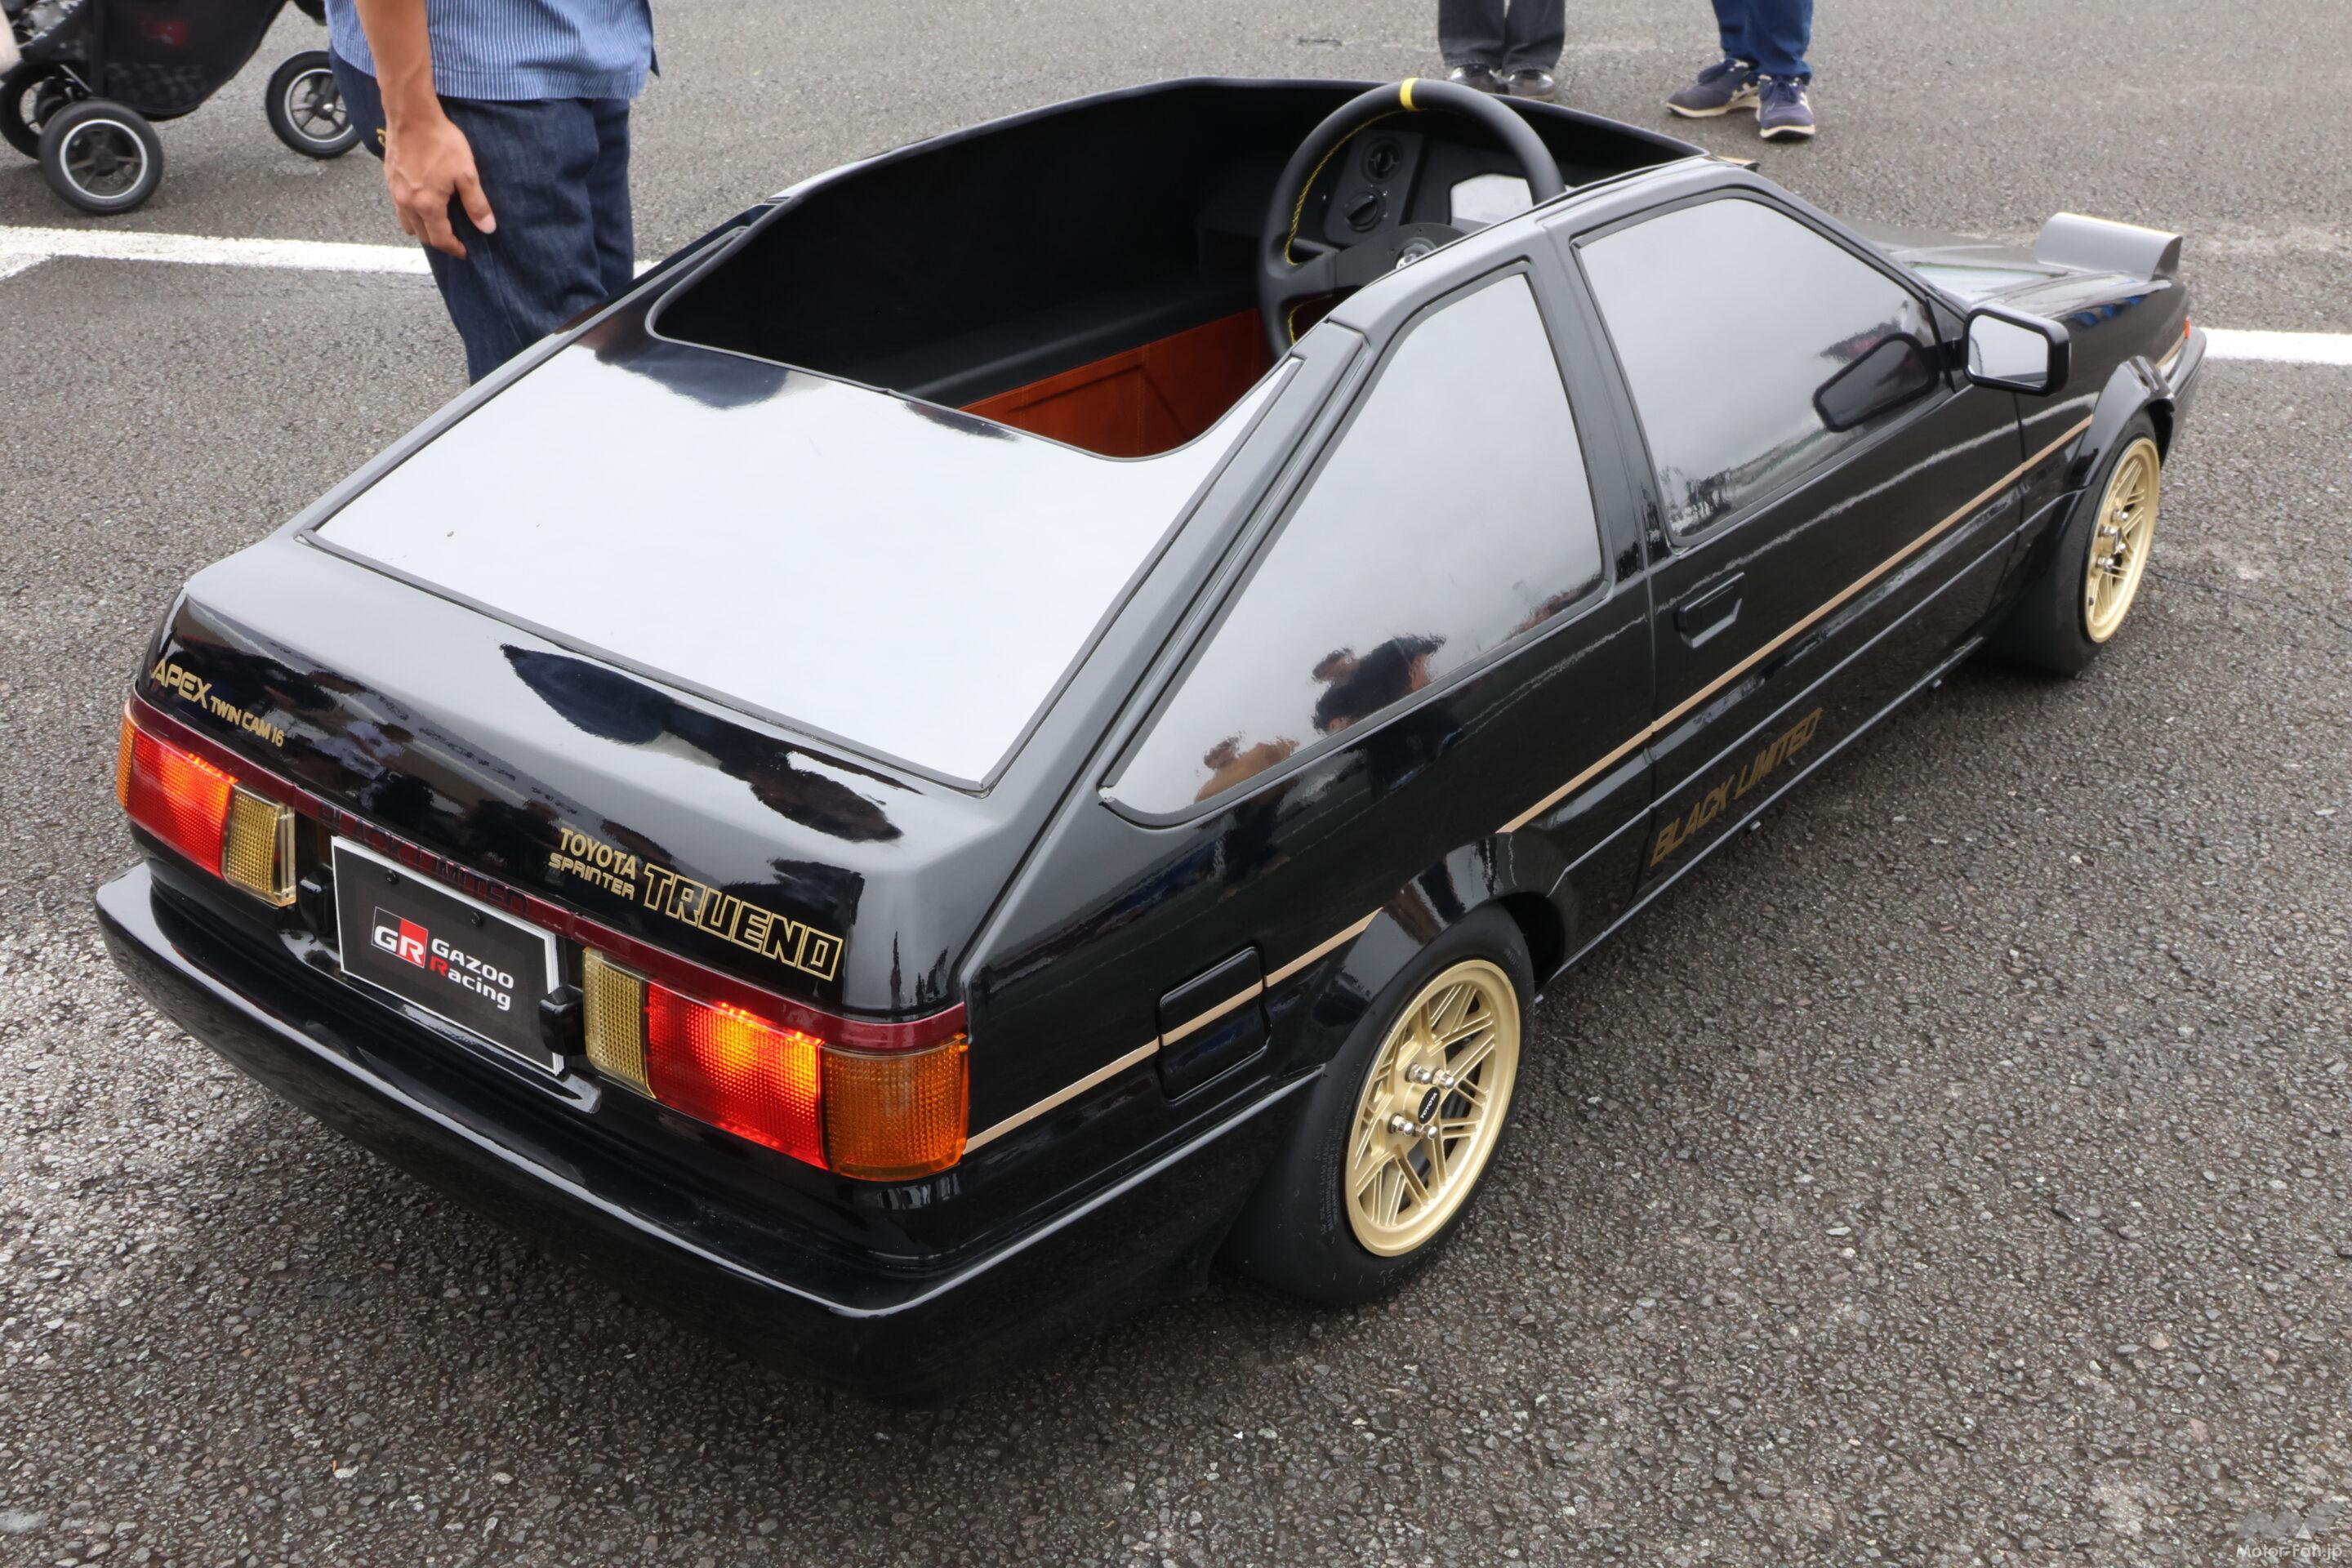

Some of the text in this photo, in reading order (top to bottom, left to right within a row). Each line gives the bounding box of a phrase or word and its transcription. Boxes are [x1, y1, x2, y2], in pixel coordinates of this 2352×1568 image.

[151, 659, 284, 747] APEX TWIN CAM 16
[1650, 706, 1823, 868] BLACK LIMITED
[548, 852, 635, 901] SPRINTER
[559, 826, 637, 881] TOYOTA
[373, 924, 425, 965] GR
[644, 862, 844, 982] TRUENO
[429, 956, 511, 1012] Racing
[430, 938, 514, 989] GAZOO
[1419, 1092, 1438, 1119] TOYOTA
